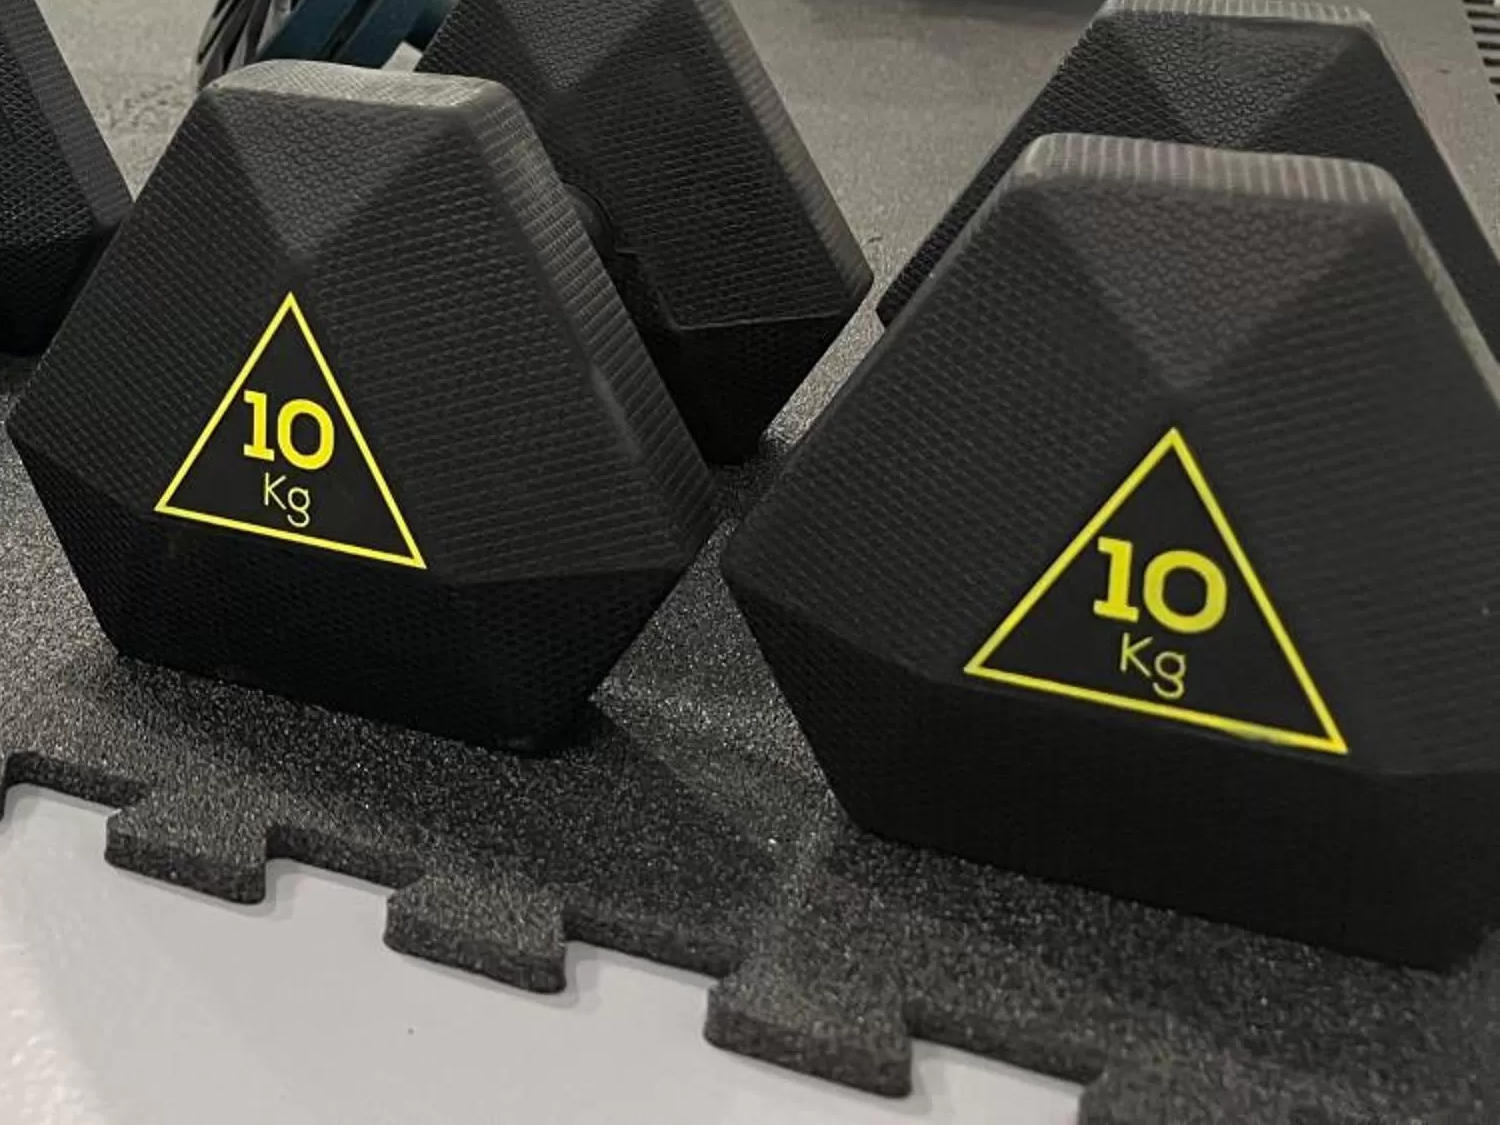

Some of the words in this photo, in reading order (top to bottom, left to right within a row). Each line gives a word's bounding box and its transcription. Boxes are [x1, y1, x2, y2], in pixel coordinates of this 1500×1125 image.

[243, 389, 335, 470] 10
[264, 472, 311, 527] Kg
[1093, 536, 1227, 634] 10
[1120, 632, 1187, 699] Kg
